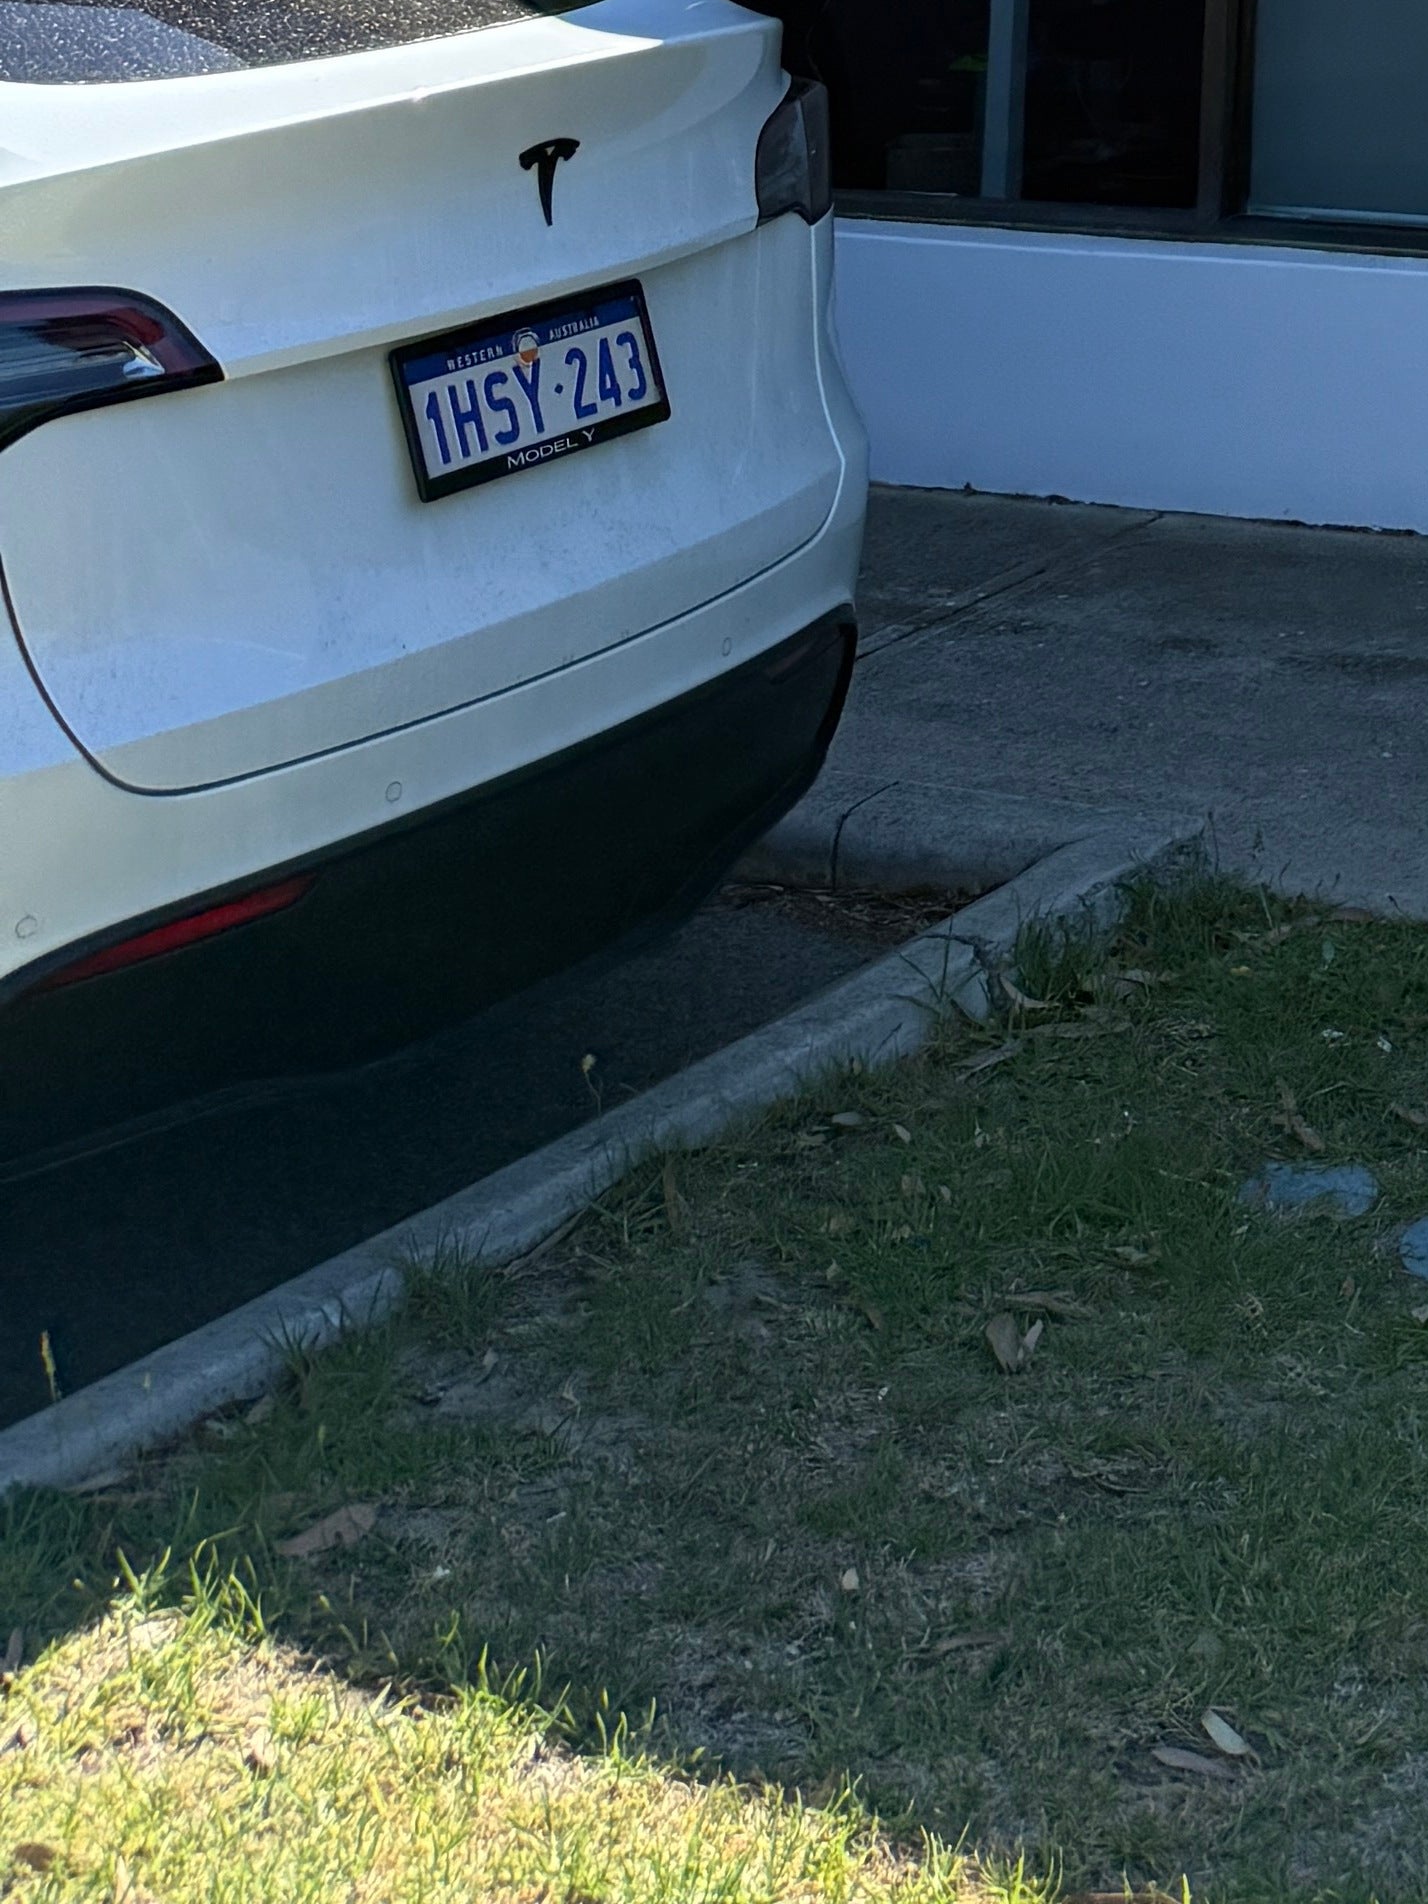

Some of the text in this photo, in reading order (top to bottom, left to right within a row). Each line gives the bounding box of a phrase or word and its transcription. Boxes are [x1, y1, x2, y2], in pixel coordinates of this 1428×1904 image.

[447, 316, 600, 371] WESTERN AUSTRALIA
[507, 428, 596, 470] MODEL Y
